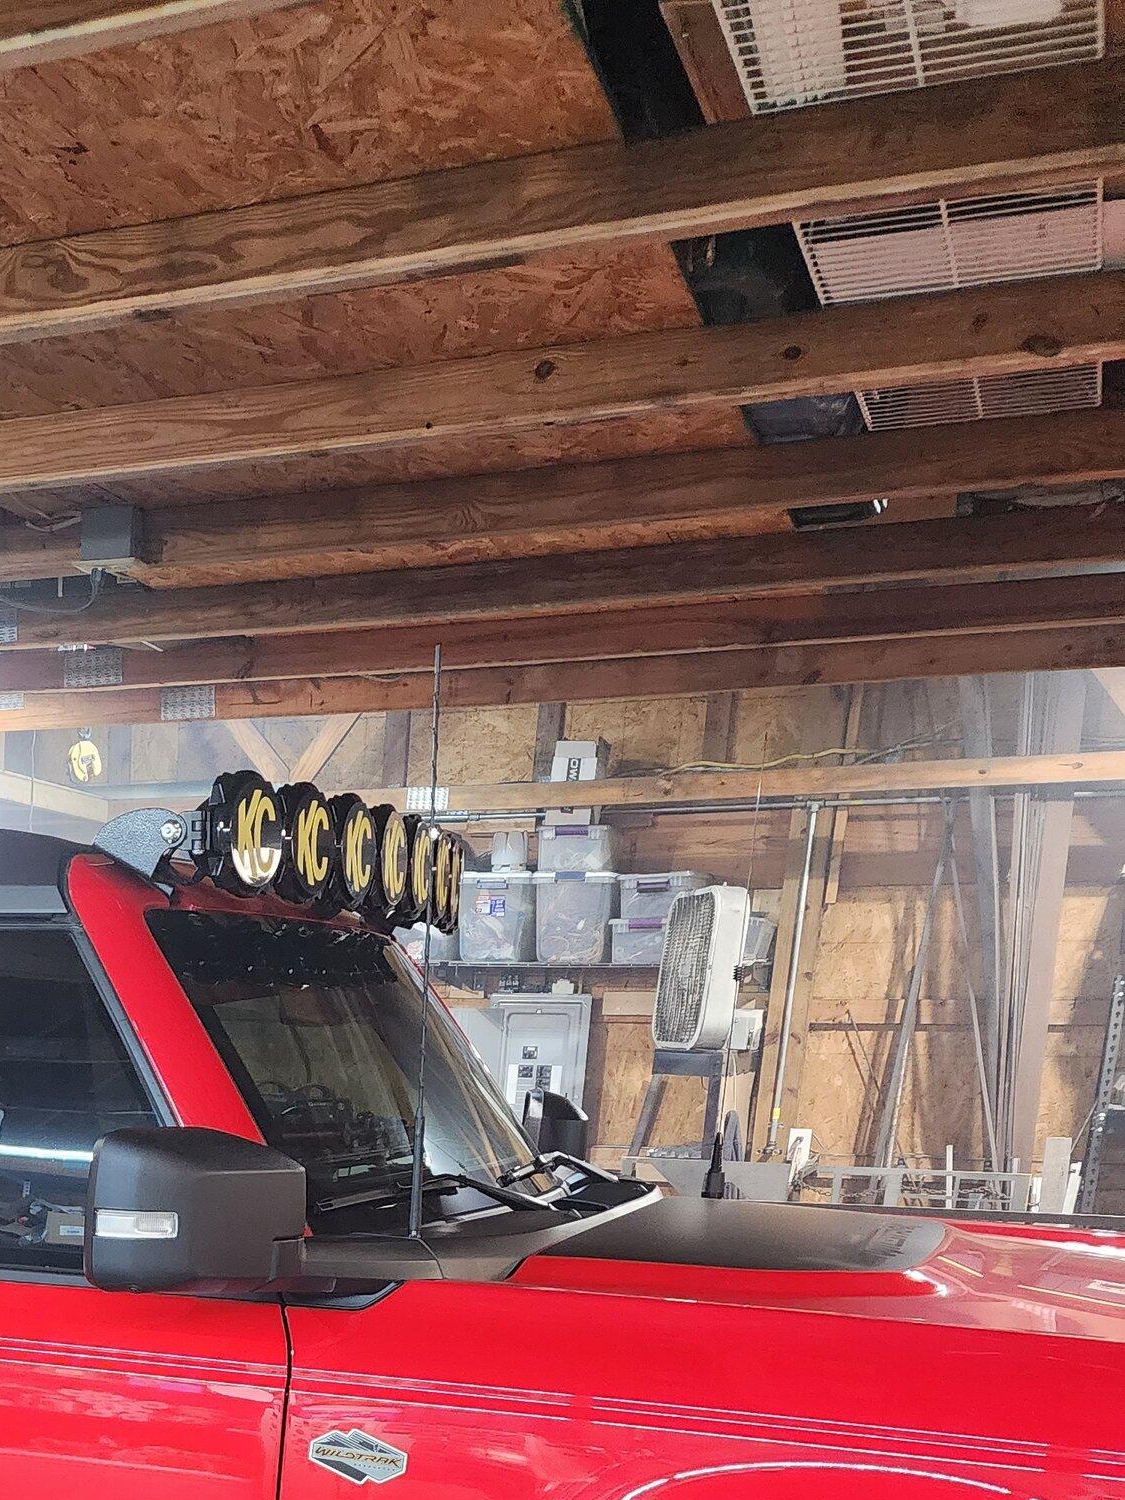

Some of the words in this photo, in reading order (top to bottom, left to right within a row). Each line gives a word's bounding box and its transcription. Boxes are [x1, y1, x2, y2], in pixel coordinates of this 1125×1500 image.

[238, 789, 277, 880] KC
[297, 800, 329, 886] KC
[345, 810, 373, 893] KC
[384, 820, 406, 899] KC
[413, 829, 432, 905] KC
[315, 1446, 401, 1468] WILDTRAK
